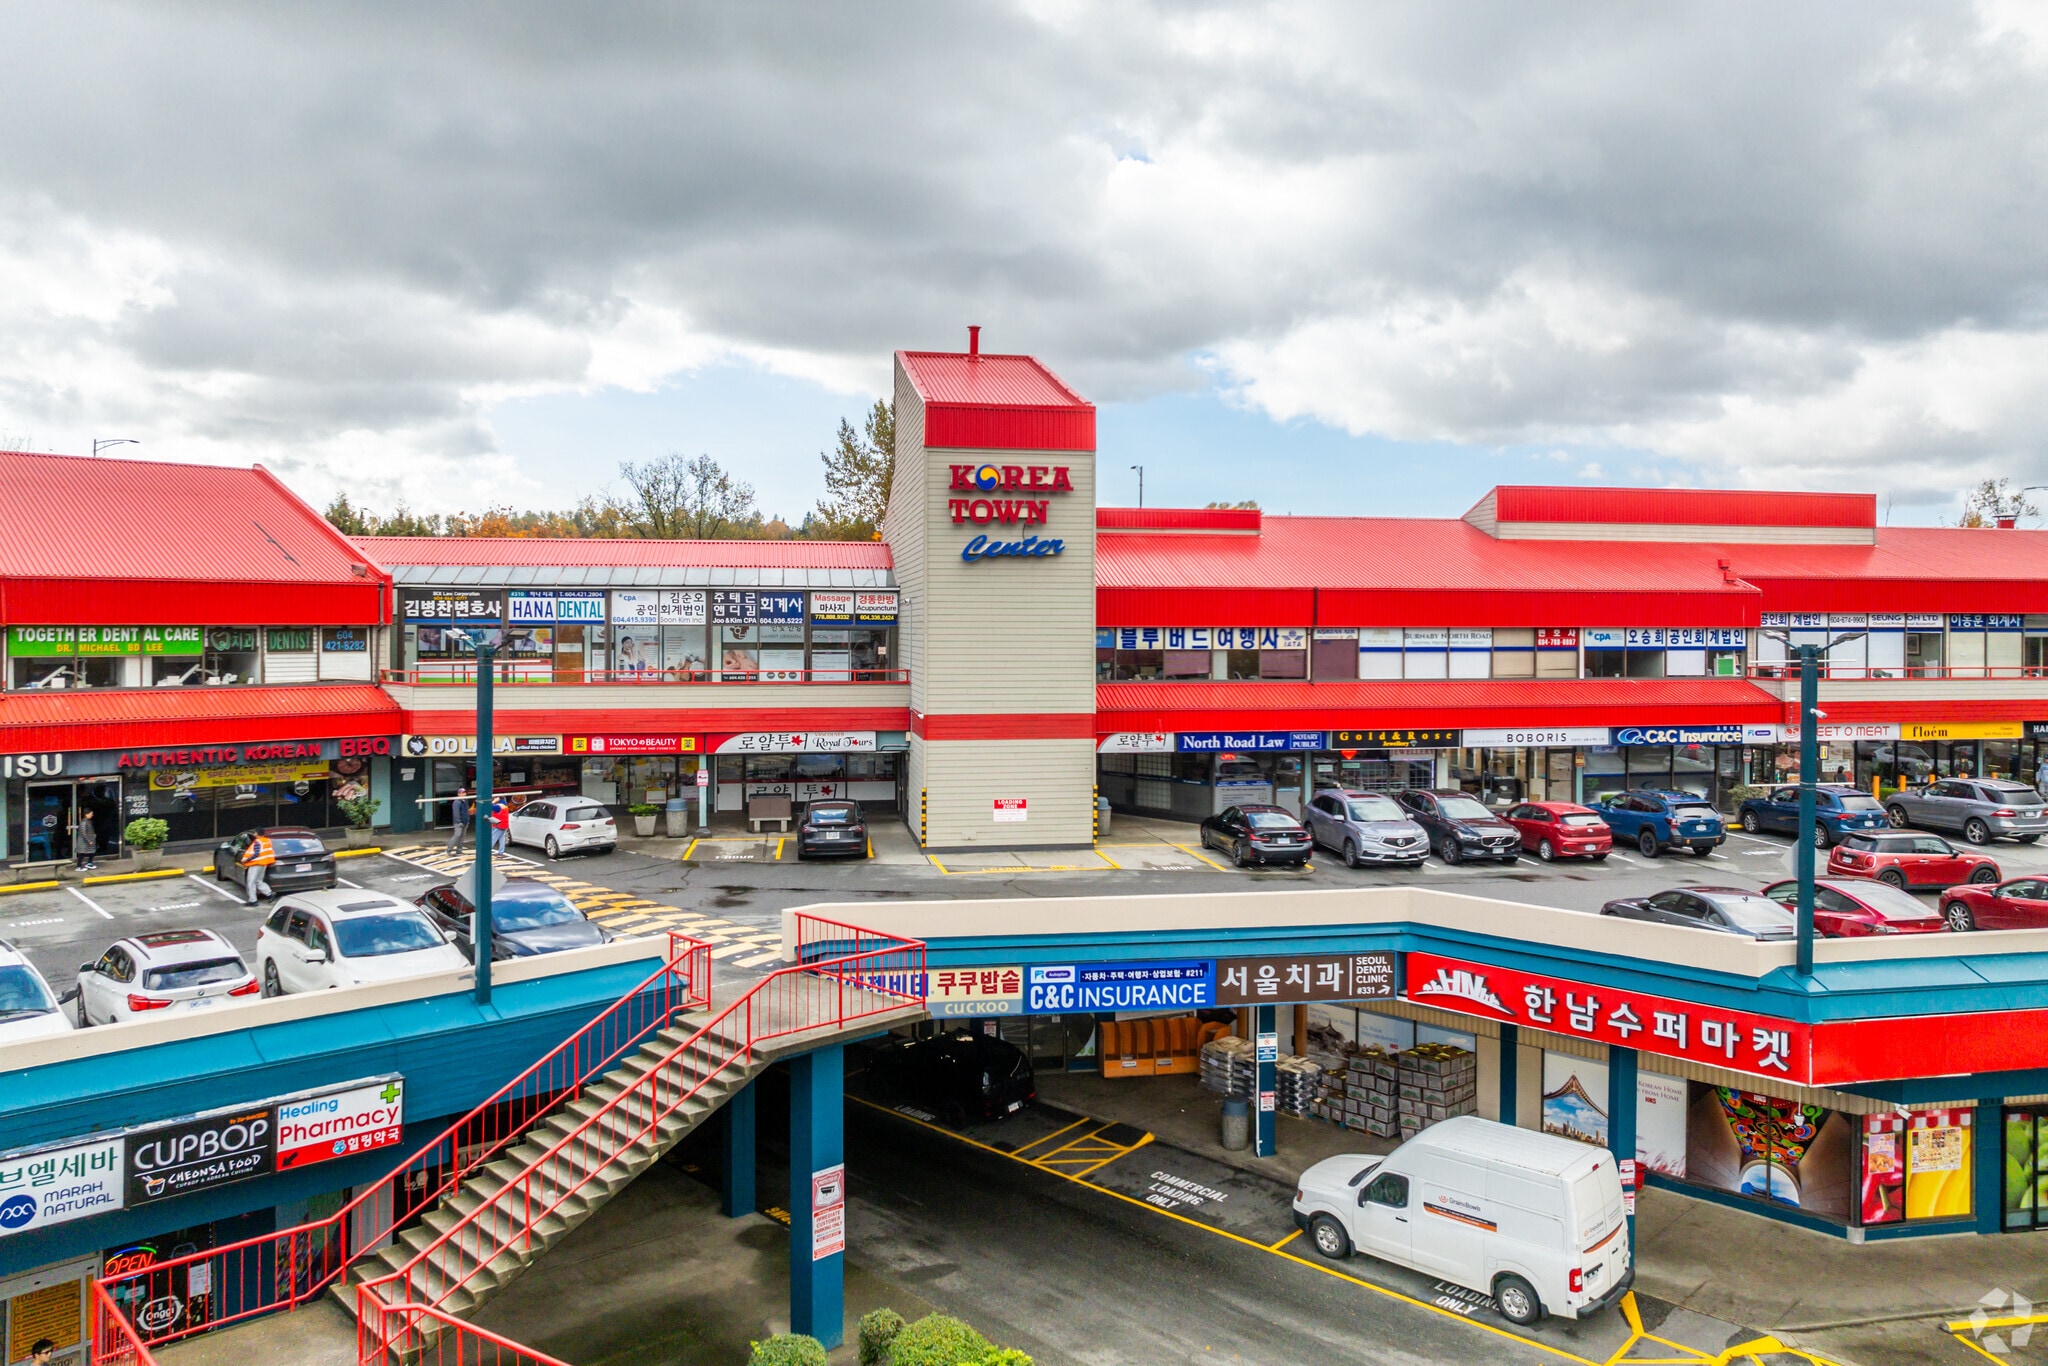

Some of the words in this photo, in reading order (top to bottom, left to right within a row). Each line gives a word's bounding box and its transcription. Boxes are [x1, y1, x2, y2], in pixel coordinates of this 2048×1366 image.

[949, 464, 1074, 492] KOREA
[949, 499, 1050, 524] TOWN
[962, 535, 1065, 562] Center
[670, 593, 704, 604] 김순오
[760, 597, 803, 613] 회계사
[815, 595, 851, 603] Massage
[405, 600, 453, 618] 김병찬
[454, 600, 502, 618] 변호사
[513, 601, 554, 618] HANA
[558, 601, 604, 618] DENTAL
[819, 603, 846, 612] 마사지
[1987, 614, 2021, 627] 회계사
[165, 628, 200, 642] CARE
[269, 630, 311, 650] DENTIST
[336, 630, 353, 640] 604
[1405, 632, 1438, 640] BURNABY
[1441, 632, 1470, 640] NORTH
[1471, 632, 1492, 641] ROAD
[1628, 629, 1665, 645] 오승희
[1669, 629, 1744, 645] 공인회계법인
[56, 643, 73, 653] DR.
[79, 643, 121, 652] MICHAEL
[146, 643, 163, 652] LEE
[325, 640, 365, 651] 421-8282
[1507, 733, 1567, 743] BOBORIS
[1646, 730, 1678, 743] C&C
[1680, 729, 1743, 743] Insurance
[1856, 725, 1890, 736] MEAT
[430, 736, 459, 753] OO
[609, 738, 638, 746] TOKYO
[646, 738, 677, 746] BEAUTY
[813, 736, 842, 749] Royal
[1183, 736, 1219, 748] North
[1223, 735, 1256, 748] Road
[1259, 735, 1285, 747] Law
[117, 746, 238, 768] AUTHENTIC
[244, 743, 321, 761] KOREAN
[340, 737, 391, 758] BBQ
[4, 753, 63, 778] ISU
[1356, 956, 1387, 966] SEOUL
[1186, 968, 1203, 978] #211
[1356, 965, 1393, 975] DENTAL
[937, 970, 1020, 996] 쿠쿠밥솥
[1221, 962, 1344, 997] 서울치과
[1356, 974, 1388, 984] CLINIC
[1030, 984, 1074, 1010] C&C
[1079, 983, 1207, 1008] INSURANCE
[1357, 986, 1375, 995] #331
[945, 1001, 1009, 1014] CUCKOO
[1522, 983, 1791, 1073] 한남수퍼마켓
[279, 1099, 339, 1121] Healing
[279, 1106, 399, 1145] Pharmacy
[134, 1119, 268, 1170] CUPBOP
[348, 1128, 400, 1152] 힐링약국
[0, 1146, 118, 1191] 브엘세바
[167, 1161, 226, 1184] CHEONSA
[229, 1154, 261, 1170] FOOD
[44, 1181, 103, 1203] MARAH
[1148, 1182, 1205, 1206] LOADING
[1150, 1171, 1229, 1203] COMMERCIAL
[44, 1193, 116, 1217] NATURAL
[1145, 1194, 1180, 1209] ONLY
[816, 1210, 841, 1223] IMMEDIATE
[816, 1216, 841, 1229] CUSTOMER
[814, 1223, 832, 1235] PARKING
[832, 1220, 843, 1229] ONLY
[105, 1253, 154, 1277] OPEN
[1435, 1295, 1479, 1315] ONLY
